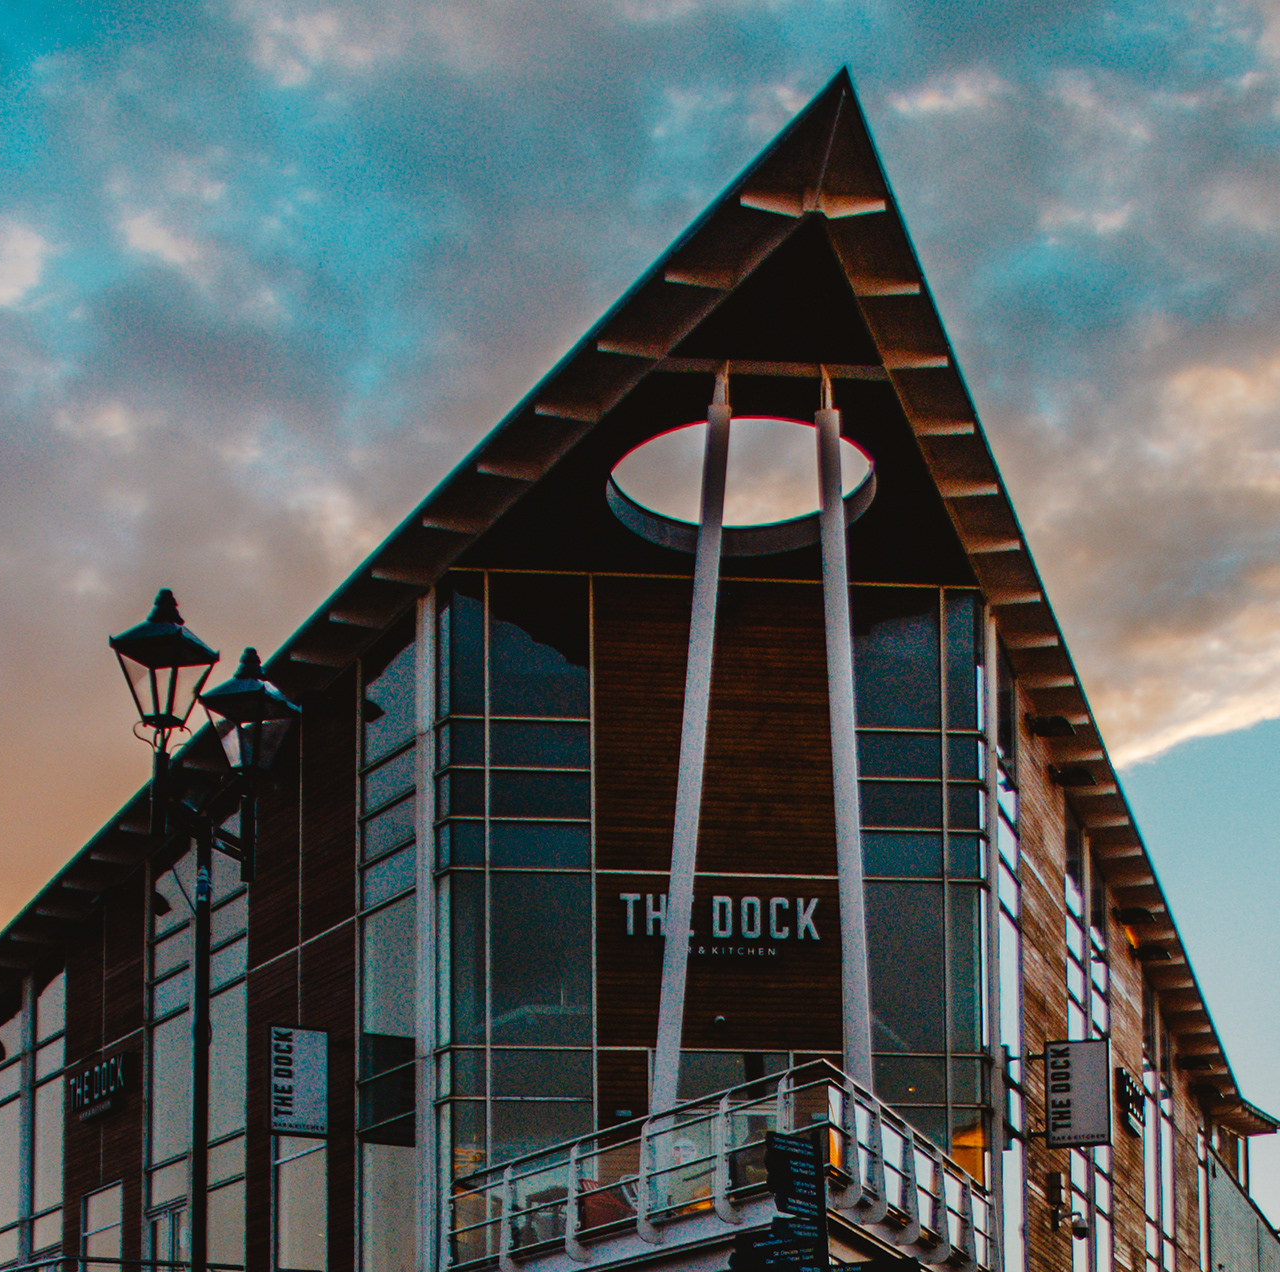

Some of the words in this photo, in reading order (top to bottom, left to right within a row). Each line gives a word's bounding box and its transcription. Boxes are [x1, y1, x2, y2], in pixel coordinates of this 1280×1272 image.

[619, 892, 695, 937] TH
[712, 895, 821, 941] DOCK
[711, 946, 777, 957] KITCHEN
[273, 1030, 293, 1078] DOCK
[1051, 1047, 1071, 1093] DOCK
[69, 1070, 90, 1112] THE
[93, 1053, 125, 1101] DOCK
[273, 1084, 293, 1117] THE
[1051, 1098, 1071, 1132] THE
